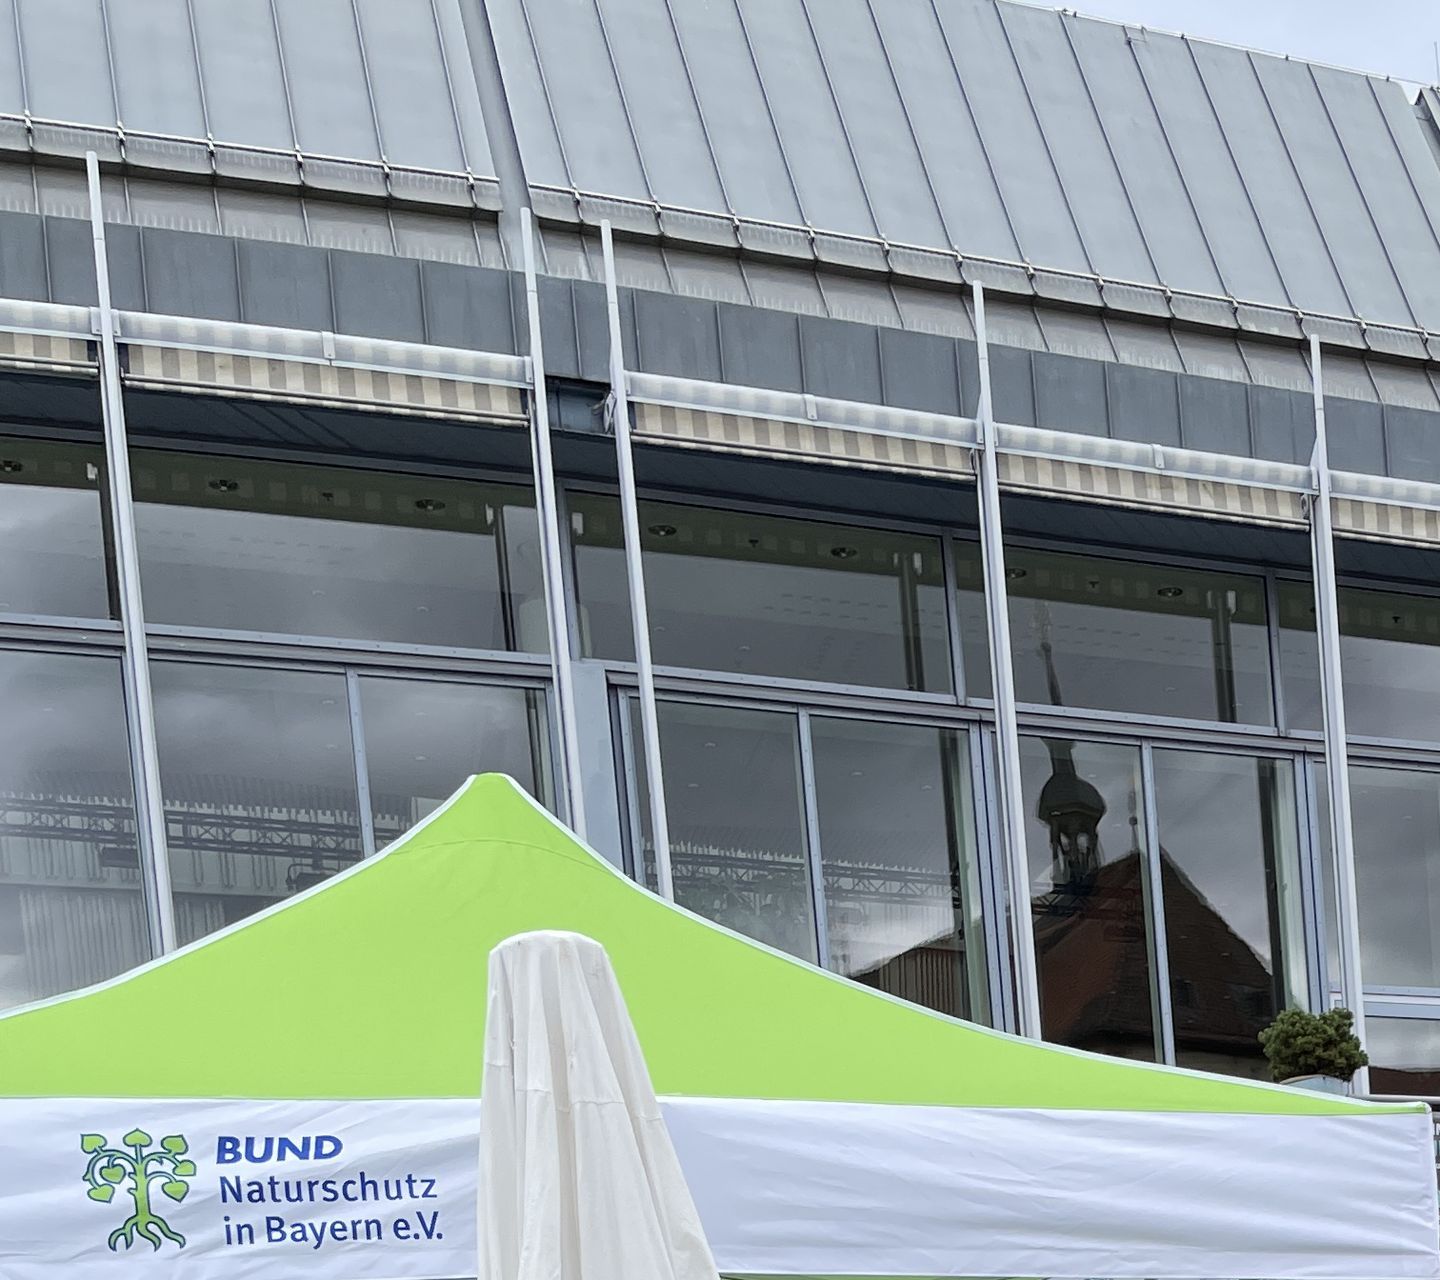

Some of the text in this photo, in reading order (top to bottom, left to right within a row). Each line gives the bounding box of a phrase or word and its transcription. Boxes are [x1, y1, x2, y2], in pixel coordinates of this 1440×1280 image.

[216, 1135, 343, 1164] BUND
[219, 1171, 438, 1204] Naturschutz
[224, 1210, 444, 1250] in Bayern e.V.
